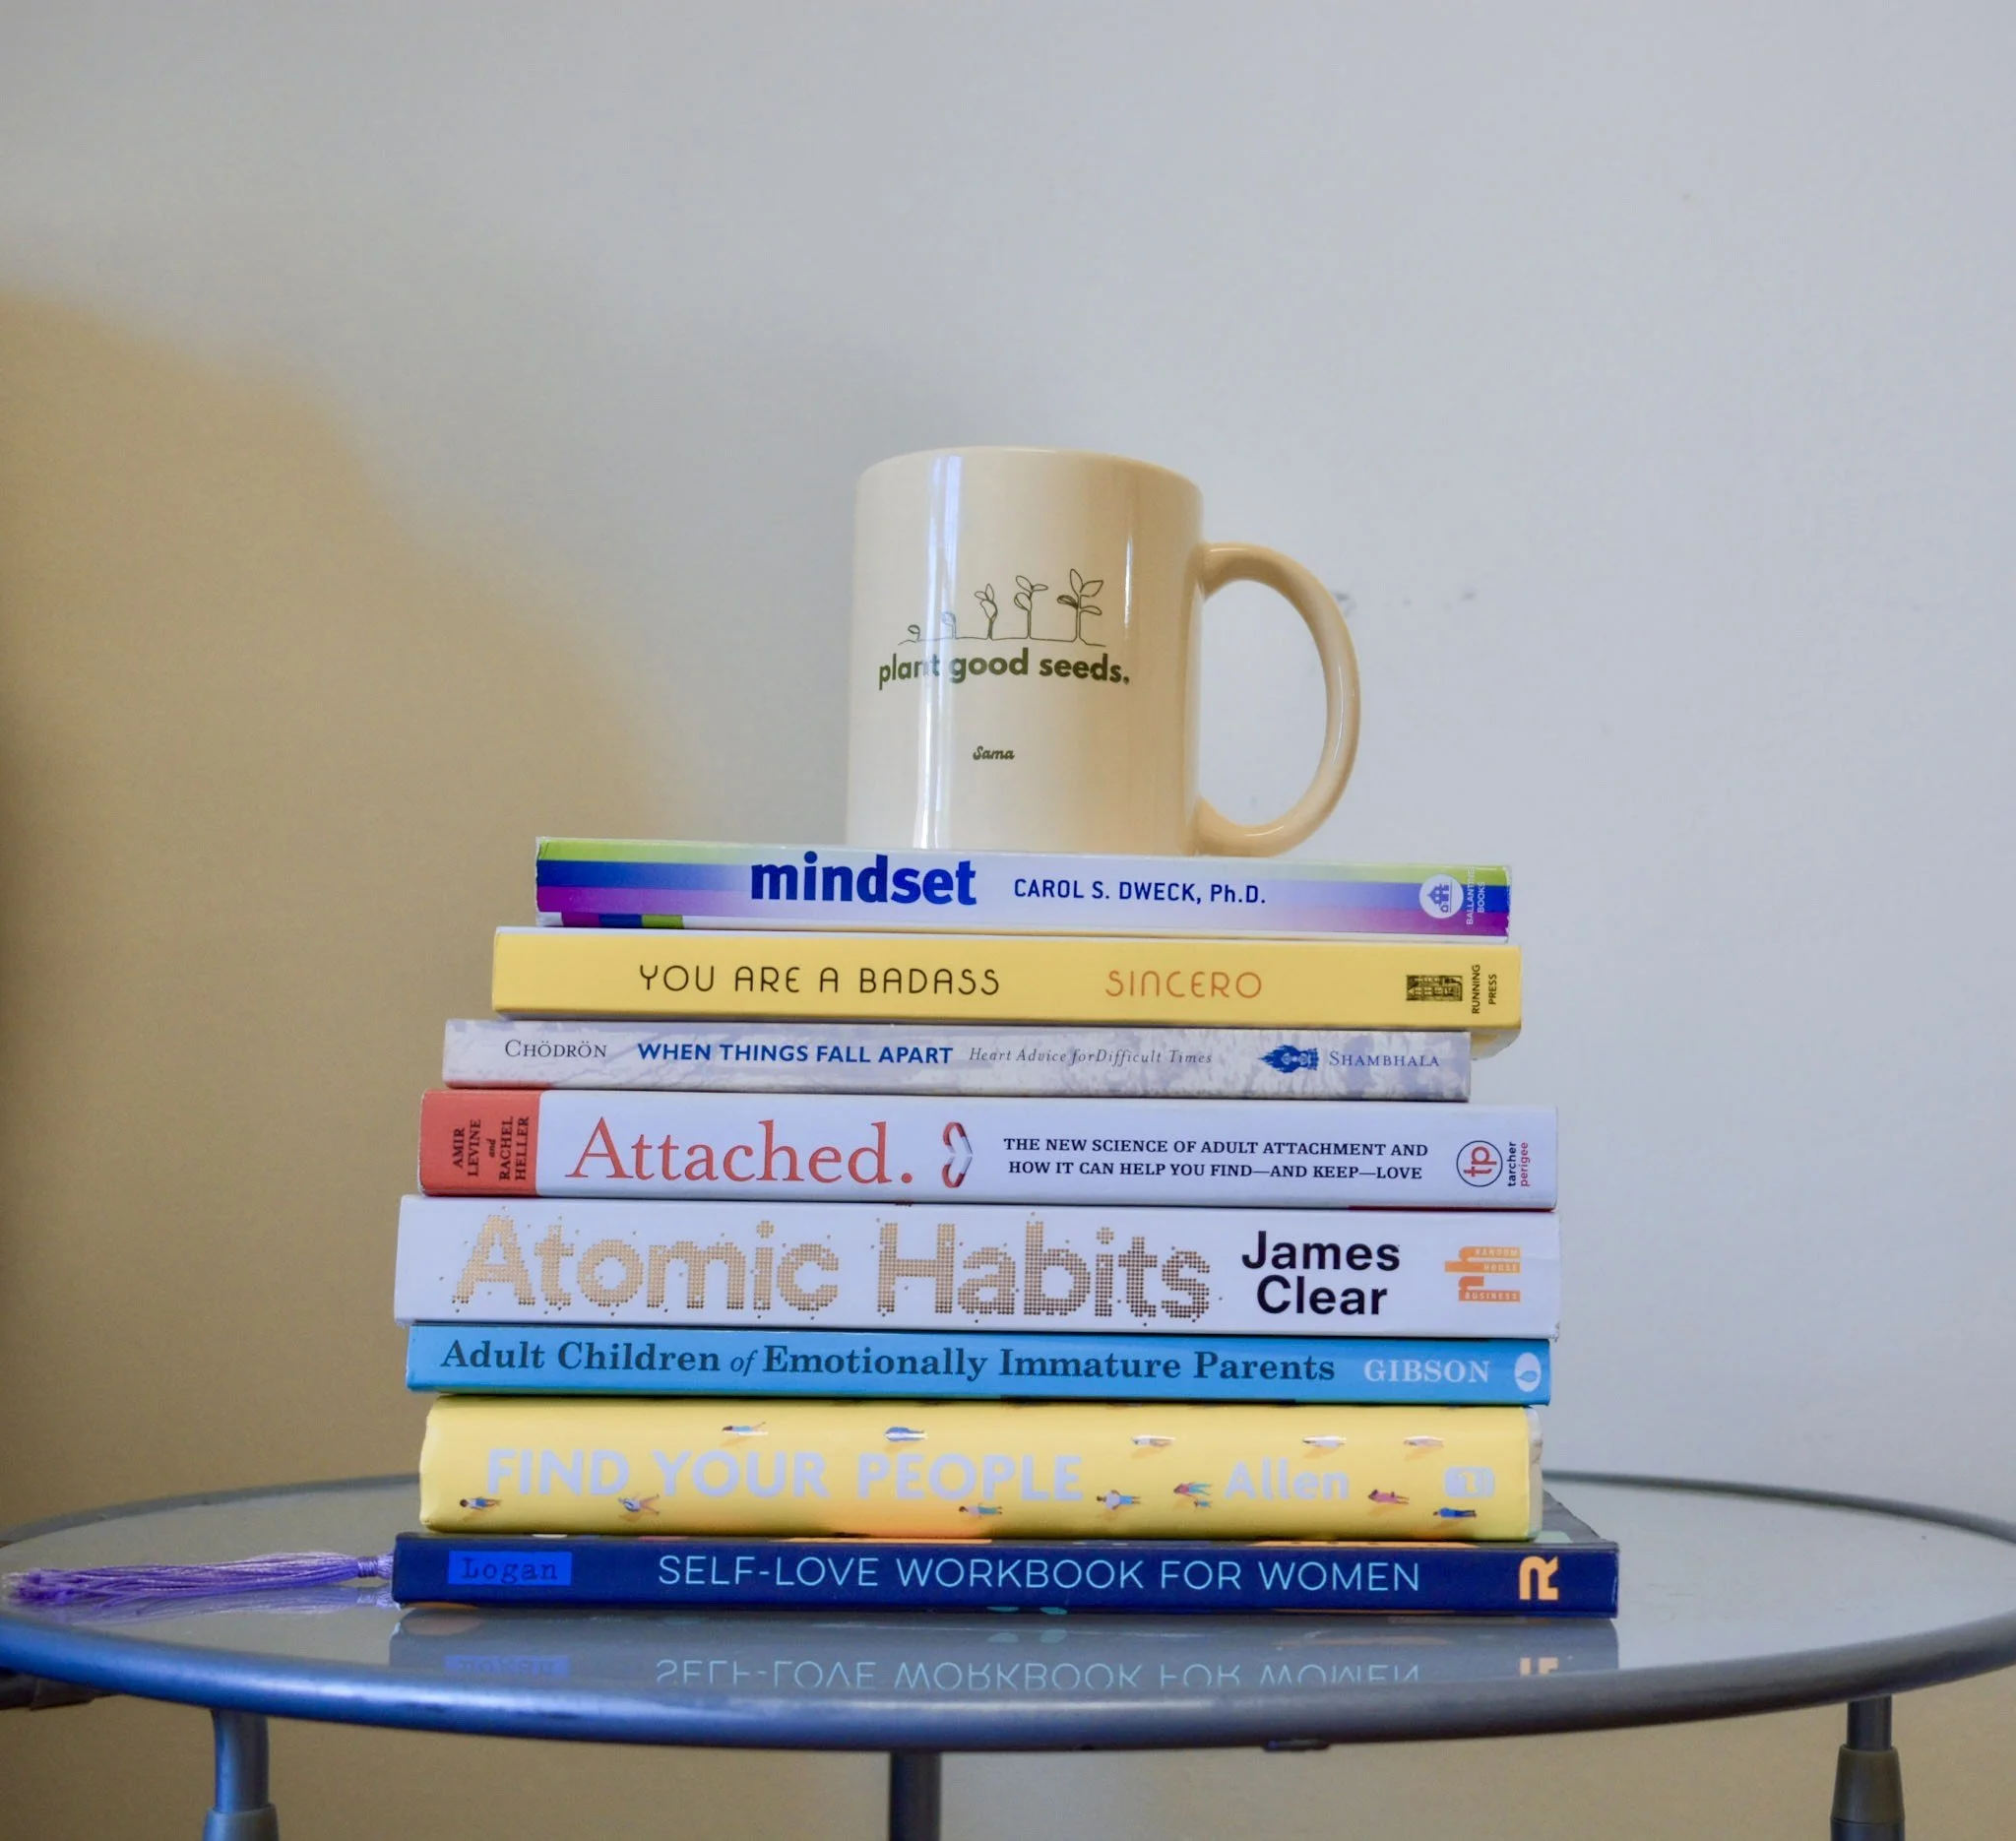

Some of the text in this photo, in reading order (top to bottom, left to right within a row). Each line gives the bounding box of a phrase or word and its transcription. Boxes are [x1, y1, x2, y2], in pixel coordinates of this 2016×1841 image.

[878, 647, 1131, 691] plant good seeds.
[972, 745, 1016, 761] Sama
[750, 851, 977, 906] mindset
[1013, 878, 1267, 904] CAROL S. DWECK, Ph.D.
[1477, 881, 1485, 914] BOOKS
[639, 964, 1001, 996] YOU ARE A BADASS
[1105, 970, 1263, 999] SINCERO
[1471, 964, 1480, 1015] RUNNING
[1487, 973, 1497, 1006] PRESS
[637, 1043, 954, 1065] WHEN THINGS FALL APART
[969, 1047, 1013, 1062] Heart
[1015, 1048, 1067, 1063] Advice
[1169, 1049, 1214, 1064] Times
[452, 1127, 466, 1170] AMIR
[468, 1118, 481, 1177] LEVINE
[486, 1137, 497, 1158] and
[499, 1115, 514, 1180] RACHEL
[515, 1116, 530, 1180] HELLER
[565, 1116, 914, 1184] Attached.
[1003, 1137, 1428, 1158] THE NEW SCIENCE OF ADULT ATTACHMENT AND
[1506, 1141, 1517, 1187] tarcher
[1519, 1142, 1531, 1187] perigee
[1008, 1161, 1051, 1174] HOW
[1055, 1162, 1074, 1174] IT
[1079, 1162, 1115, 1175] CAN
[1119, 1163, 1166, 1176] HELP
[1169, 1164, 1205, 1177] YOU
[451, 1214, 1211, 1320] Atomic Habits
[1242, 1231, 1400, 1271] James
[1482, 1263, 1519, 1273] HOUSE
[1256, 1275, 1388, 1315] Clear
[1464, 1291, 1519, 1301] BUSINESS
[441, 1340, 1335, 1381] Adult Children of Emotionally Immature Parents
[1364, 1358, 1490, 1383] GIBSON
[488, 1449, 1084, 1501] FIND YOUR PEOPLE
[1224, 1459, 1350, 1501] Allen
[461, 1556, 558, 1584] Logan
[658, 1555, 1420, 1592] SELF-LOVE WORKBOOK FOR WOMEN
